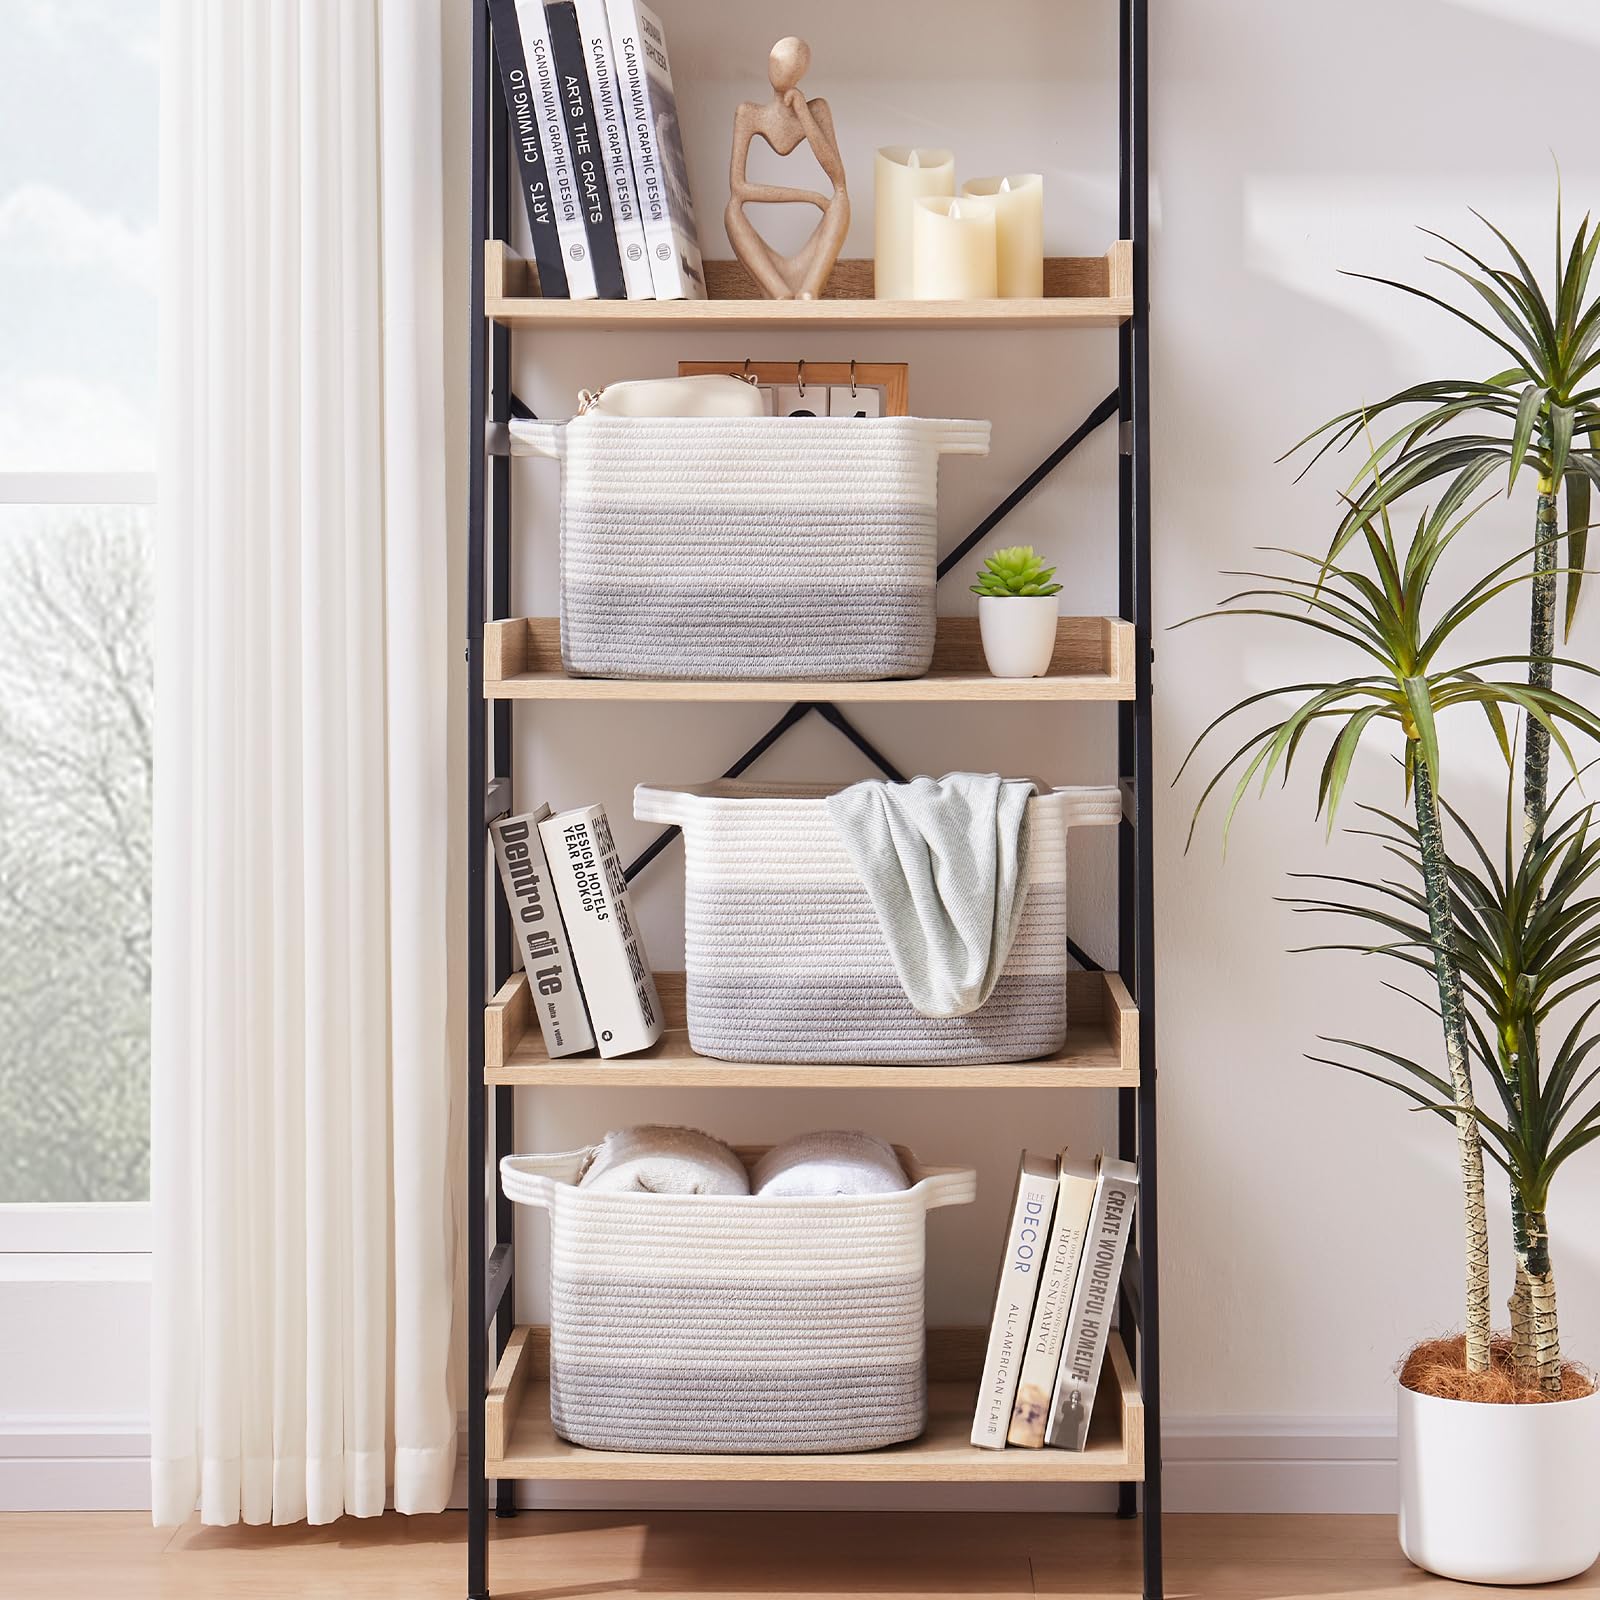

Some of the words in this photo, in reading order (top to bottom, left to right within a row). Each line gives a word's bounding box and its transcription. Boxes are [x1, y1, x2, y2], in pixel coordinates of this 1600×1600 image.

[509, 70, 525, 90] LO
[565, 75, 583, 117] ARTS
[514, 93, 532, 133] WING
[533, 39, 557, 121] SCANDINAVIAV
[549, 124, 566, 174] GRAPHIC
[559, 178, 576, 221] DESIGN
[591, 39, 615, 121] SCANDINAVIAV
[607, 125, 625, 175] GRAPHIC
[616, 179, 633, 221] DESIGN
[622, 38, 645, 121] SCANDINAVIAV
[637, 124, 655, 175] GRAPHIC
[646, 178, 662, 220] DESIGN
[524, 137, 538, 162] CHI
[573, 123, 591, 155] THE
[530, 182, 549, 223] ARTS
[581, 162, 602, 223] CRAFTS
[563, 827, 580, 859] YEAR
[499, 821, 545, 923] Dentro
[575, 823, 596, 869] DESIGN
[587, 873, 609, 921] HOTELS
[526, 930, 559, 960] di
[536, 965, 563, 996] te
[1027, 1192, 1046, 1202] ELLE
[1101, 1191, 1126, 1236] CREATE
[1014, 1202, 1042, 1274] DECOR
[1036, 1278, 1060, 1354] DARWINS
[1053, 1228, 1071, 1273] TEORI
[1086, 1238, 1118, 1317] WONDERFUL
[993, 1303, 1019, 1396] ALL-AMERICAN
[1072, 1318, 1100, 1382] HOMELIFE
[987, 1400, 1002, 1434] FLAIR
